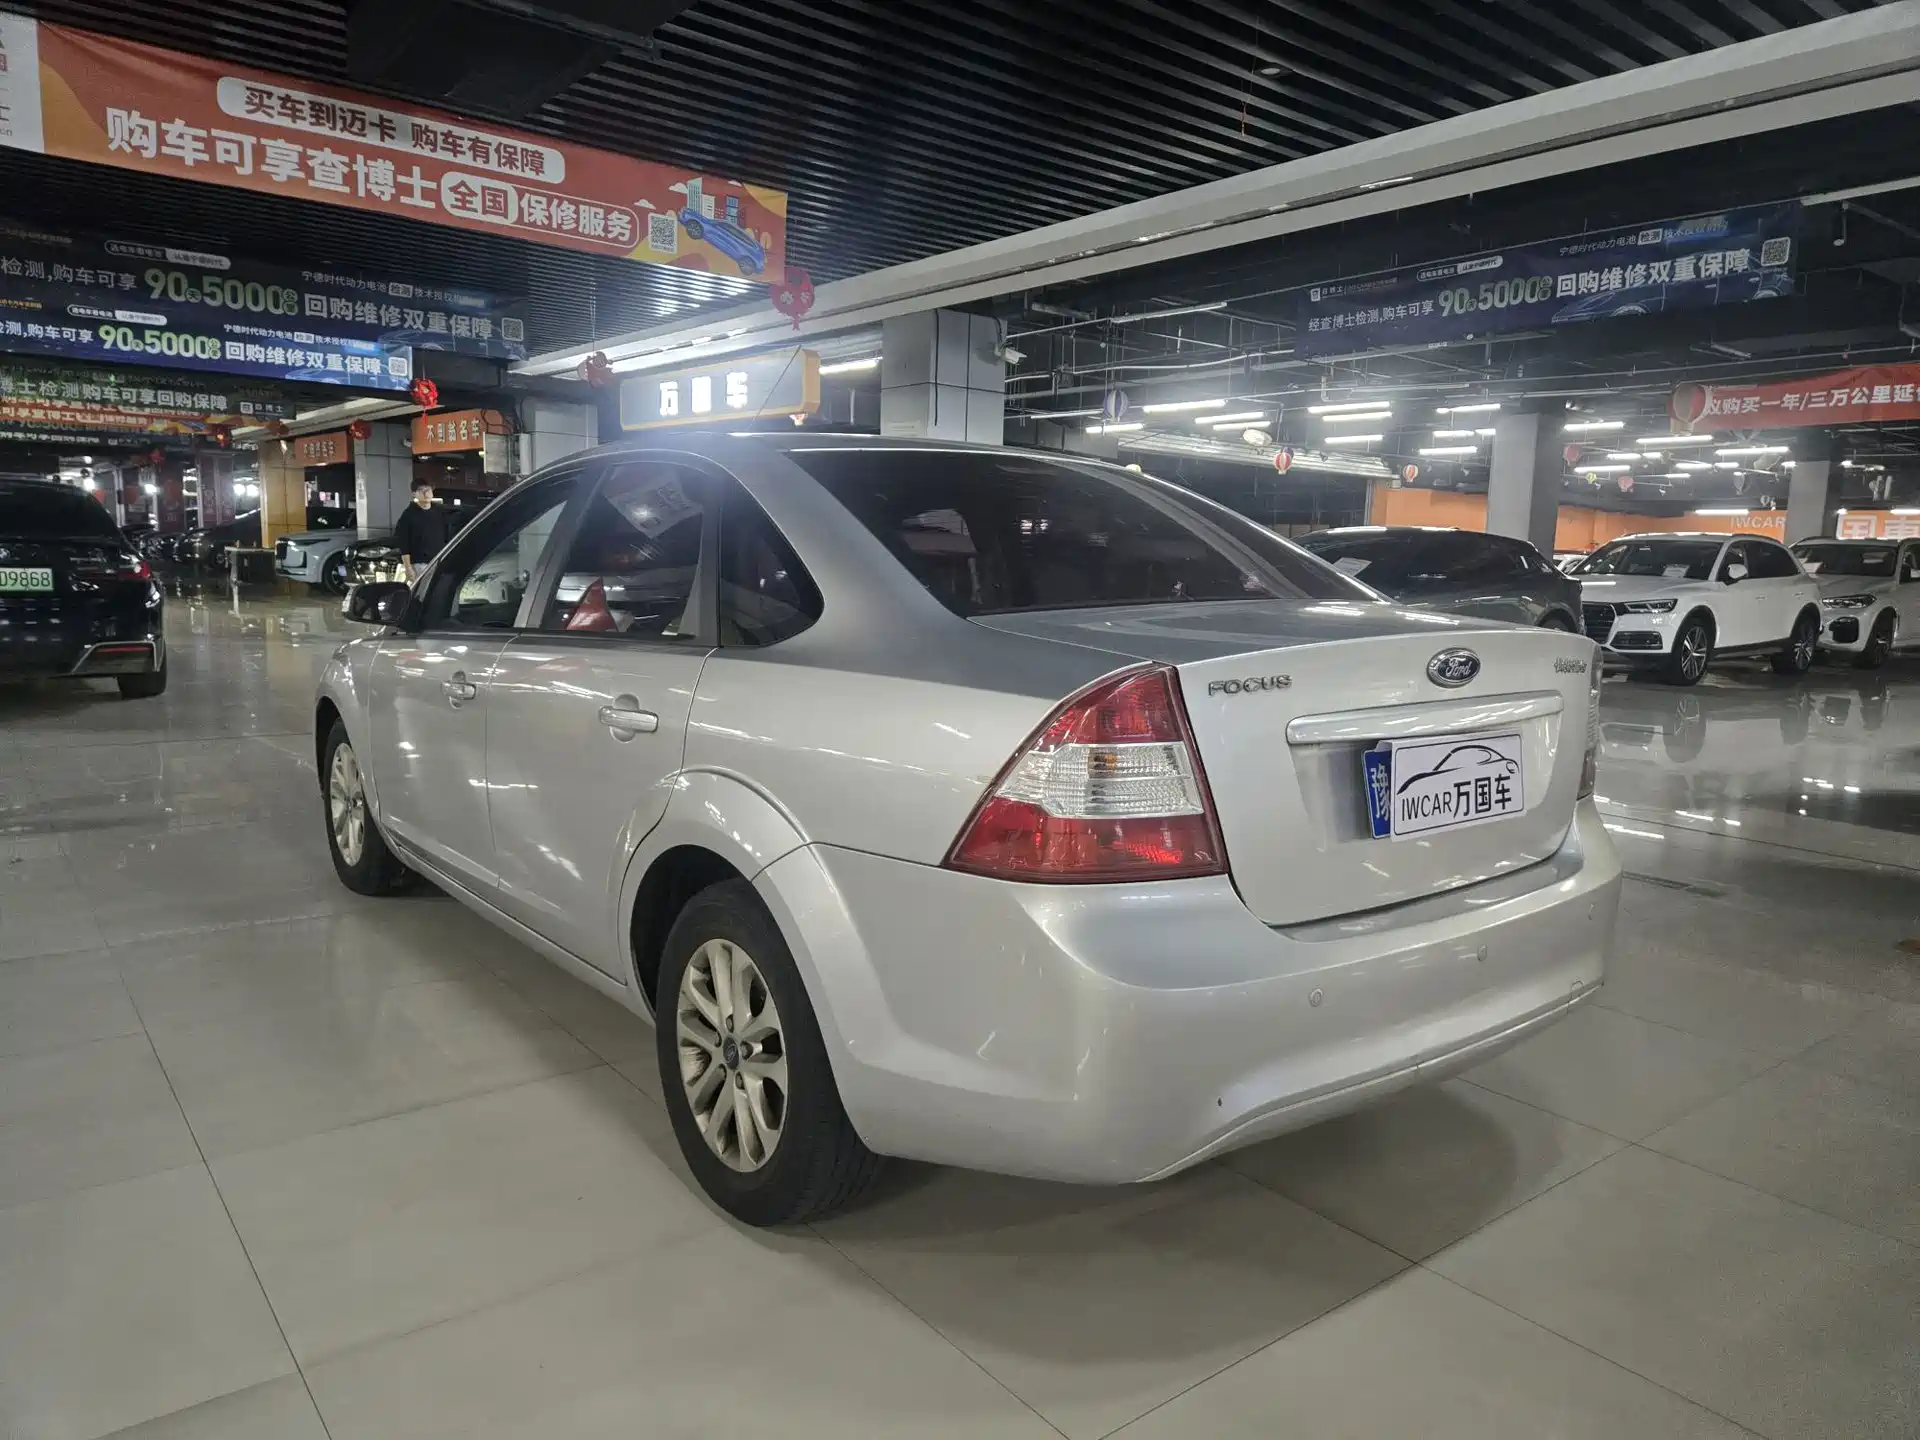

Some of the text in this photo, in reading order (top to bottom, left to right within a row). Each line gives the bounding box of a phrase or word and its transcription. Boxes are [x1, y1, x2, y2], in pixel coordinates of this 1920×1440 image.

[244, 86, 545, 177] 买车到迈卡 购车有保障
[107, 107, 632, 242] 购车可享查博士 全国 保修服务
[304, 293, 493, 340] 回购维修双重保障
[1307, 300, 1434, 332] 经查博士检测,购车可享
[1556, 248, 1750, 298] 回购维修双重保障
[225, 341, 381, 375] 回购维修双重保障
[1208, 675, 1293, 696] FOCUS
